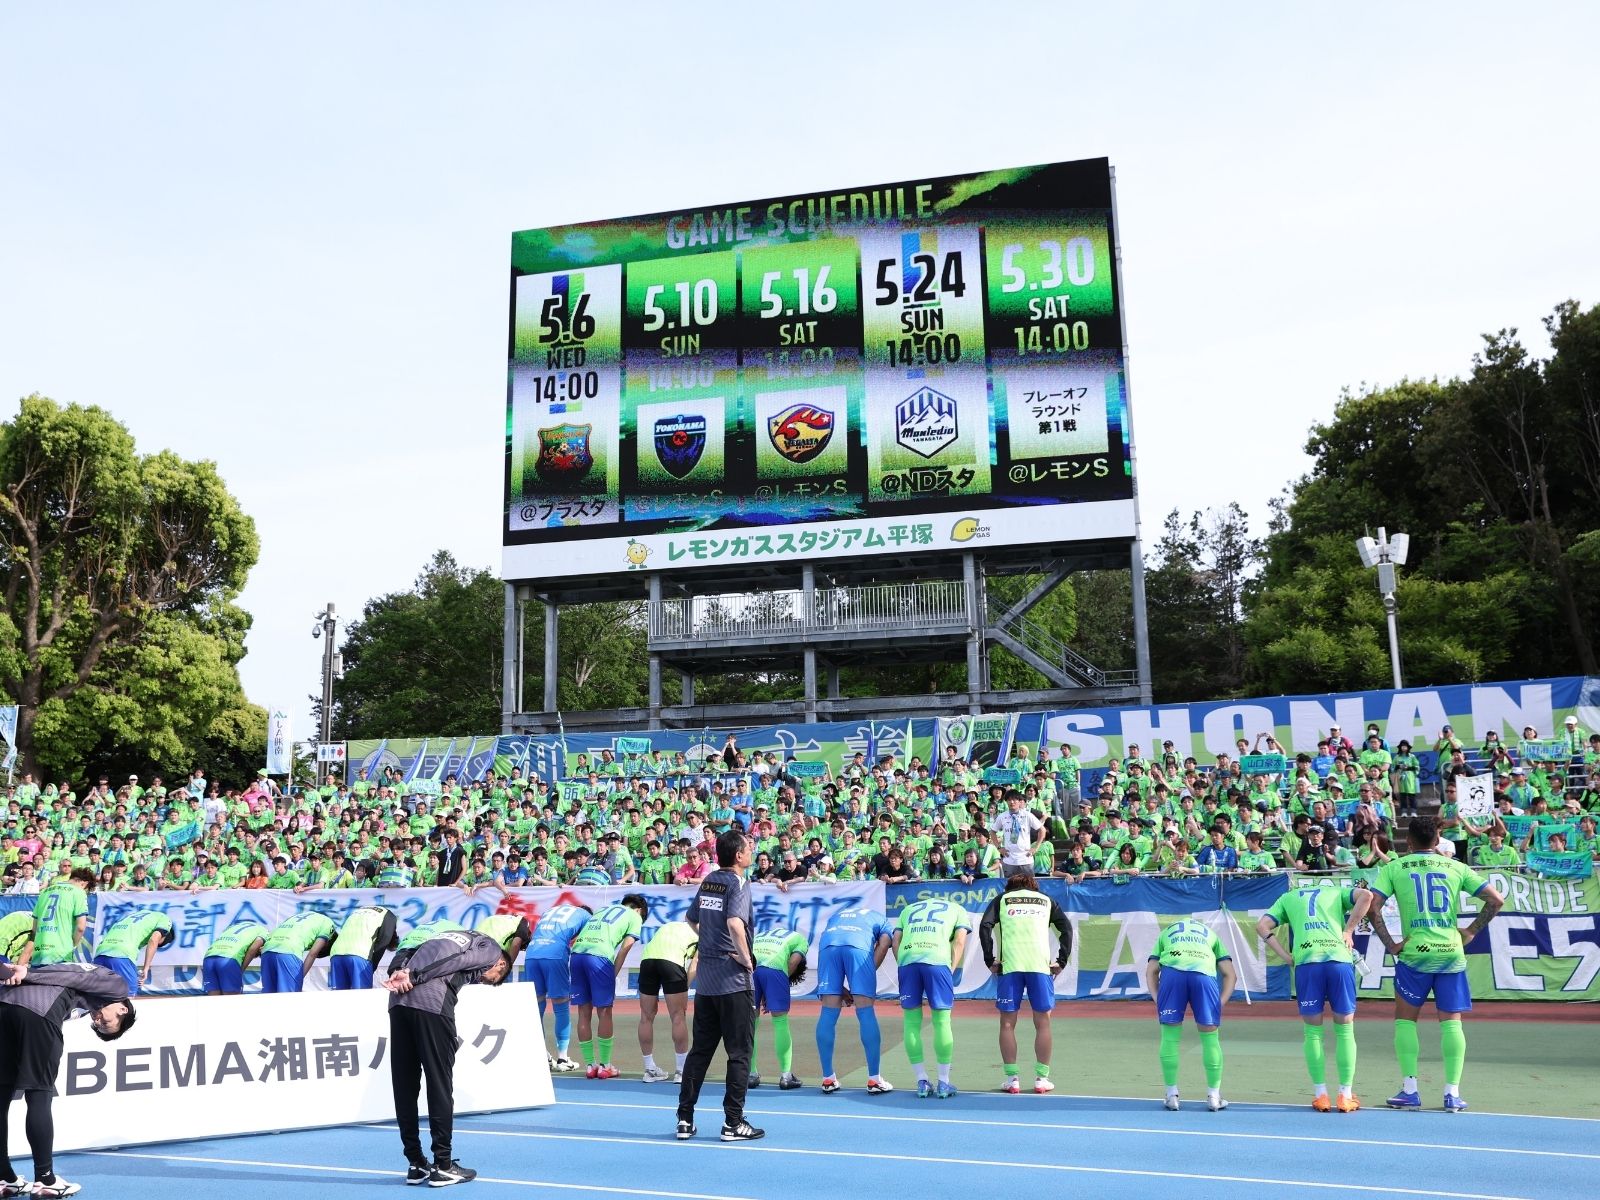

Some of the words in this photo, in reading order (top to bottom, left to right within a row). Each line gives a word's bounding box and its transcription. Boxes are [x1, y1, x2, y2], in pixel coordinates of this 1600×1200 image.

[666, 207, 752, 249] GAME
[766, 184, 933, 237] SCHEDULE
[875, 251, 966, 306] 5.24
[1001, 236, 1095, 293] 5.30
[643, 278, 718, 331] 5.10
[760, 266, 837, 319] 5.16
[539, 293, 595, 344] 5.6
[901, 308, 944, 334] SUN
[1028, 295, 1070, 321] SAT
[660, 333, 700, 358] SUN
[779, 321, 818, 346] SAT
[1014, 321, 1090, 355] 14:00
[546, 347, 586, 370] WED
[886, 333, 961, 367] 14:00
[533, 371, 599, 404] 14:00
[1032, 403, 1081, 418] ラウンド
[1039, 419, 1077, 434] 第1戦
[881, 467, 976, 493] @NDスタ
[1009, 458, 1109, 483] @レモンS
[668, 523, 934, 561] レモンガススタジアム平塚
[973, 720, 999, 729] RIDE
[1046, 684, 1554, 766] SHONAN
[563, 787, 579, 800] 86
[1299, 888, 1321, 917] 7
[1410, 872, 1449, 913] 16
[43, 894, 60, 921] 3
[908, 901, 949, 924] 22
